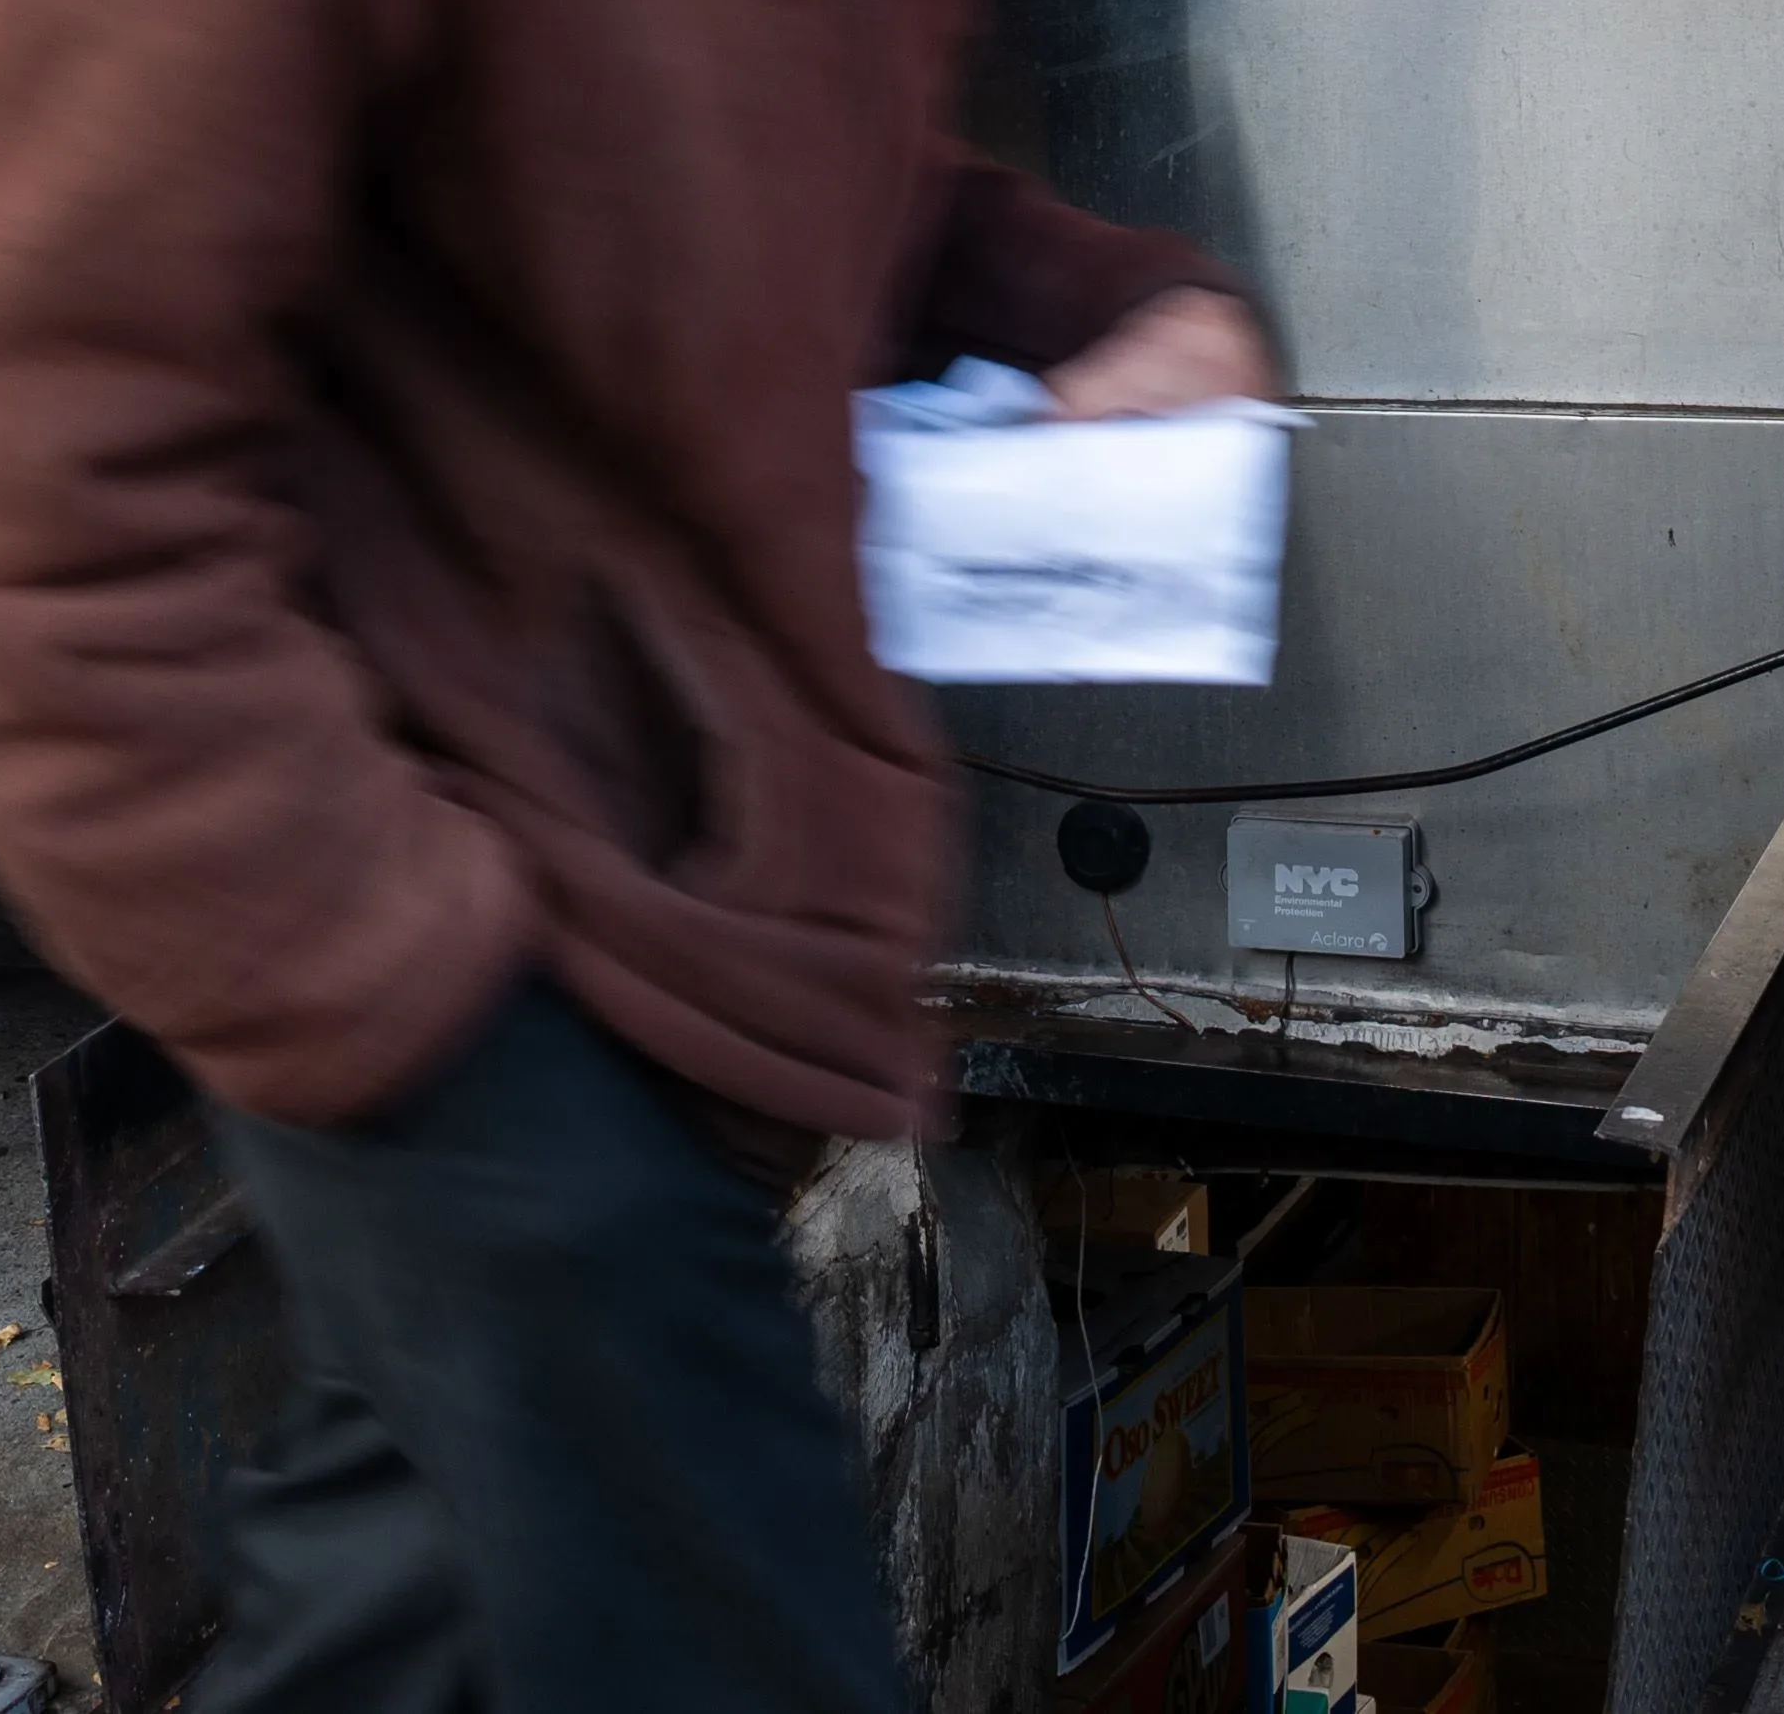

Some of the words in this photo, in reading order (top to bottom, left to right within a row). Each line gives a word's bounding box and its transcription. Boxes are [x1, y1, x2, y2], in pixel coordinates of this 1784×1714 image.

[1275, 863, 1359, 897] NYC
[1274, 895, 1343, 909] Environmental
[1274, 906, 1324, 918] Protection
[1310, 930, 1365, 949] Aclara
